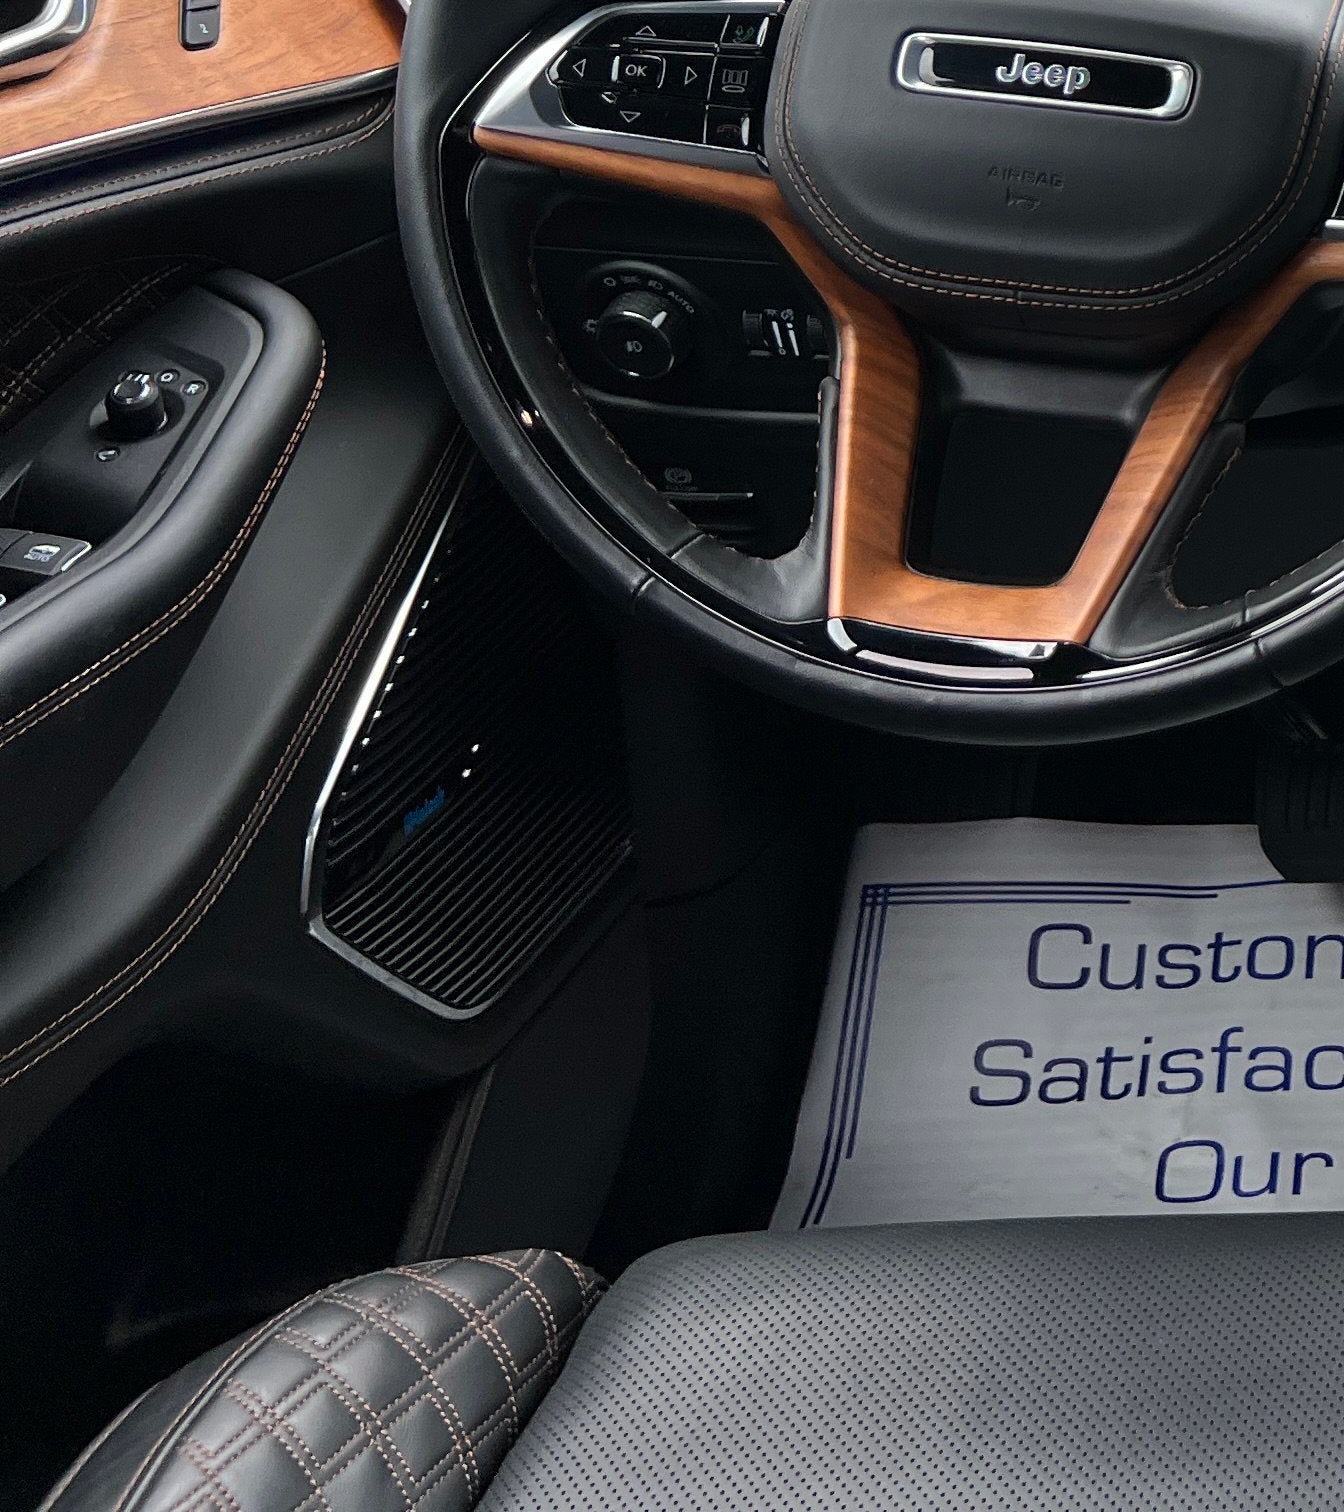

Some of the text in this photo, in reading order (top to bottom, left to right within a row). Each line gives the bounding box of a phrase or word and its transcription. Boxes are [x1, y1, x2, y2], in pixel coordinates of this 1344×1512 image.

[625, 64, 648, 78] OK
[995, 53, 1091, 95] Jeep
[988, 166, 1065, 189] AIRBAG
[667, 291, 695, 314] AUTO
[1154, 1138, 1335, 1205] Our
